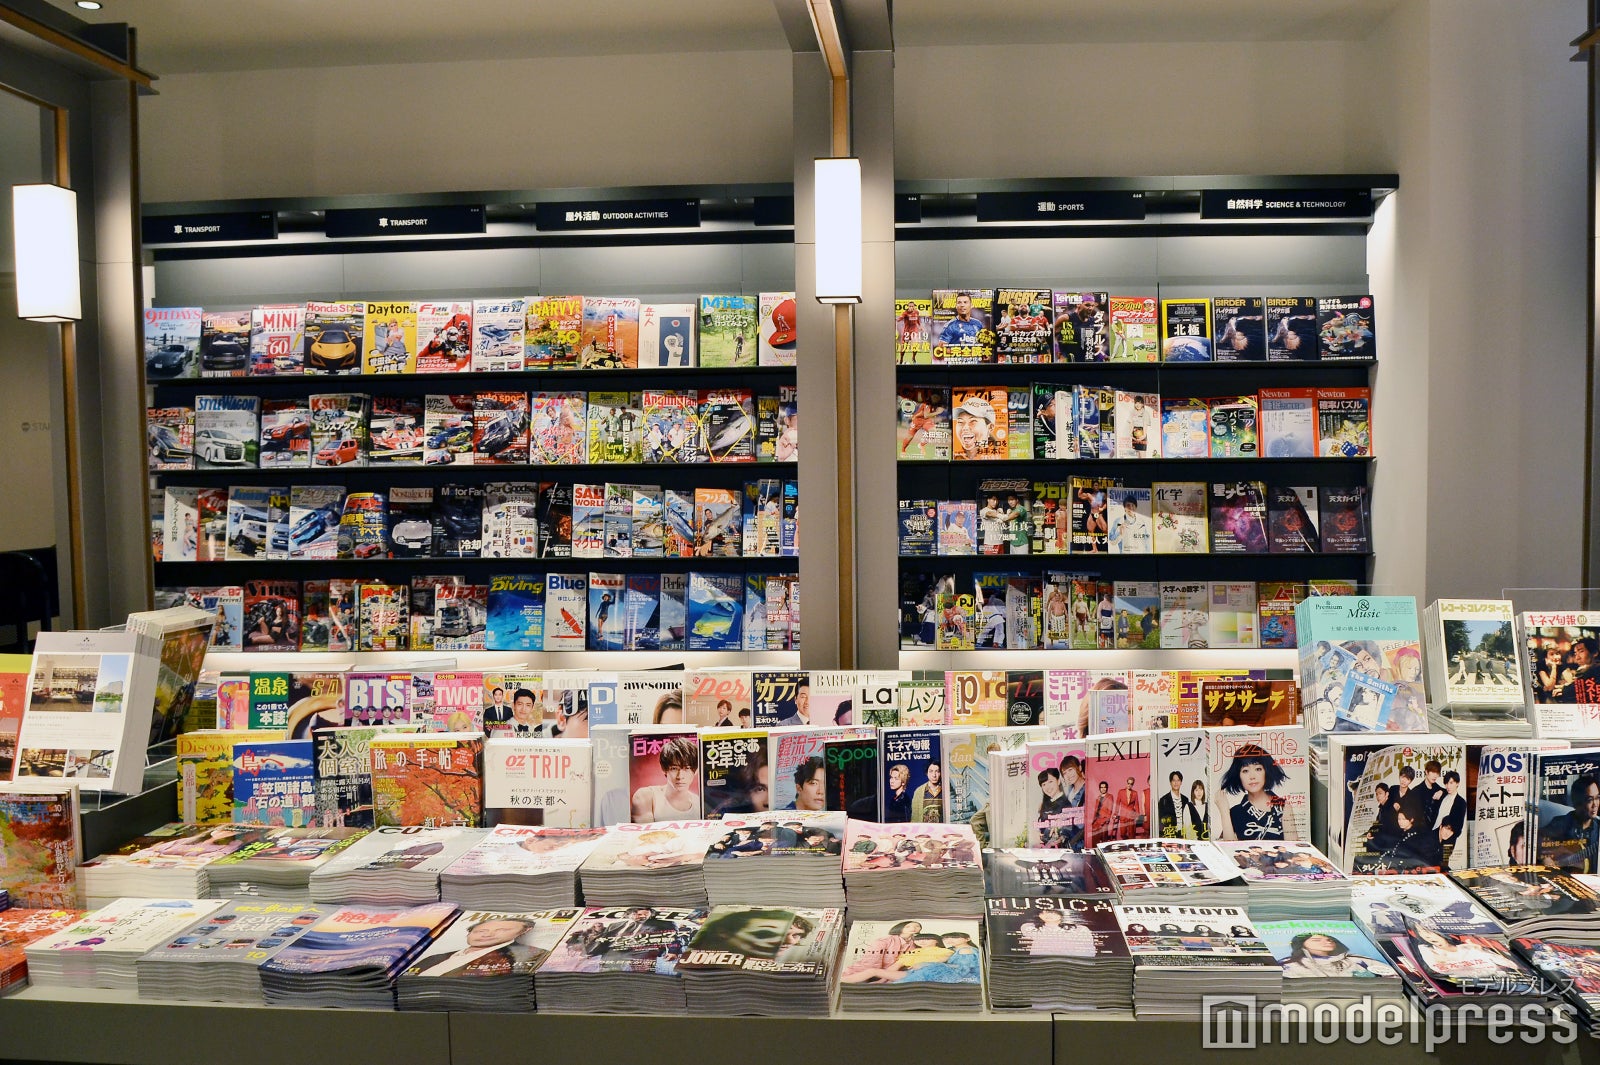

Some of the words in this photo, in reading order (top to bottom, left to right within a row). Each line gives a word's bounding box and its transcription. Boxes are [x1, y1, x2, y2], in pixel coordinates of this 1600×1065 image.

[1037, 201, 1056, 212] 運動
[1058, 203, 1085, 211] SPORTS
[1227, 199, 1263, 210] 自然科学
[1265, 201, 1294, 209] SCIENCE
[565, 211, 600, 222] 屋外活動
[602, 212, 632, 220] OUTDOOR
[634, 211, 669, 220] ACTIVITIES
[379, 218, 388, 227] 車
[390, 218, 428, 226] TRANSPORT
[174, 225, 183, 234] 車
[184, 225, 220, 233] TRANSPORT
[306, 303, 338, 313] Honda
[533, 301, 575, 316] GARVY
[170, 309, 201, 320] DAYS
[263, 313, 297, 329] MINI
[1062, 321, 1073, 330] US
[903, 331, 929, 340] 2019
[1093, 310, 1105, 356] ダブルス
[1173, 324, 1201, 336] 北極
[270, 340, 288, 355] 60
[933, 347, 993, 358] CL完全読本
[1261, 390, 1290, 398] Newton
[1317, 390, 1345, 398] Newton
[1008, 392, 1029, 410] 80
[1319, 400, 1363, 410] 確率パズル
[391, 489, 424, 500] Nostalgic
[1109, 490, 1150, 501] SWIMMING
[1156, 488, 1183, 500] 化学
[1213, 482, 1246, 500] 星ナビ
[1328, 495, 1360, 503] 天文ガイド
[461, 540, 482, 550] 冷却
[489, 580, 544, 594] Diving
[548, 575, 586, 590] Blue
[591, 578, 623, 587] NALU
[1116, 588, 1137, 597] 武道
[1162, 585, 1199, 594] 大学への数学
[959, 597, 974, 606] PJ
[1315, 604, 1343, 612] Premium
[1440, 602, 1510, 613] レコード・コレクターズ
[1347, 608, 1381, 619] Music
[1528, 614, 1577, 626] キネマ旬報
[254, 676, 288, 696] 温泉
[504, 682, 522, 690] 韓流
[1350, 671, 1364, 681] The
[1366, 676, 1396, 693] Smiths
[348, 679, 405, 710] BTS
[1058, 702, 1067, 711] 11
[1204, 690, 1285, 714] サラサーテ
[757, 703, 768, 714] 11
[755, 717, 781, 725] 五木ひろし
[887, 740, 931, 752] キネマ旬報
[374, 748, 452, 770] 旅の手帖
[505, 754, 525, 767] OZ
[887, 752, 913, 762] NEXT
[1272, 757, 1305, 766] 上原ひろみ
[530, 754, 572, 779] TRIP
[1544, 763, 1599, 776] 現代ギター
[185, 767, 194, 787] 京都
[708, 770, 719, 780] 10
[262, 781, 313, 795] 笠岡諸島
[1542, 788, 1565, 796] SUZUKI
[510, 795, 567, 806] 秋の京都へ
[1478, 786, 1525, 804] ベートー
[54, 804, 62, 812] 10
[617, 821, 711, 832] QLAP!
[494, 827, 608, 838] CINEMA
[1361, 862, 1388, 872] タレント
[988, 897, 1114, 913] MUSICA
[1122, 906, 1171, 915] PINK
[1178, 906, 1240, 916] FLOYD
[235, 915, 292, 924] LOVE
[333, 911, 399, 925] 絶景
[245, 951, 267, 960] 10
[679, 951, 746, 966] JOKER
